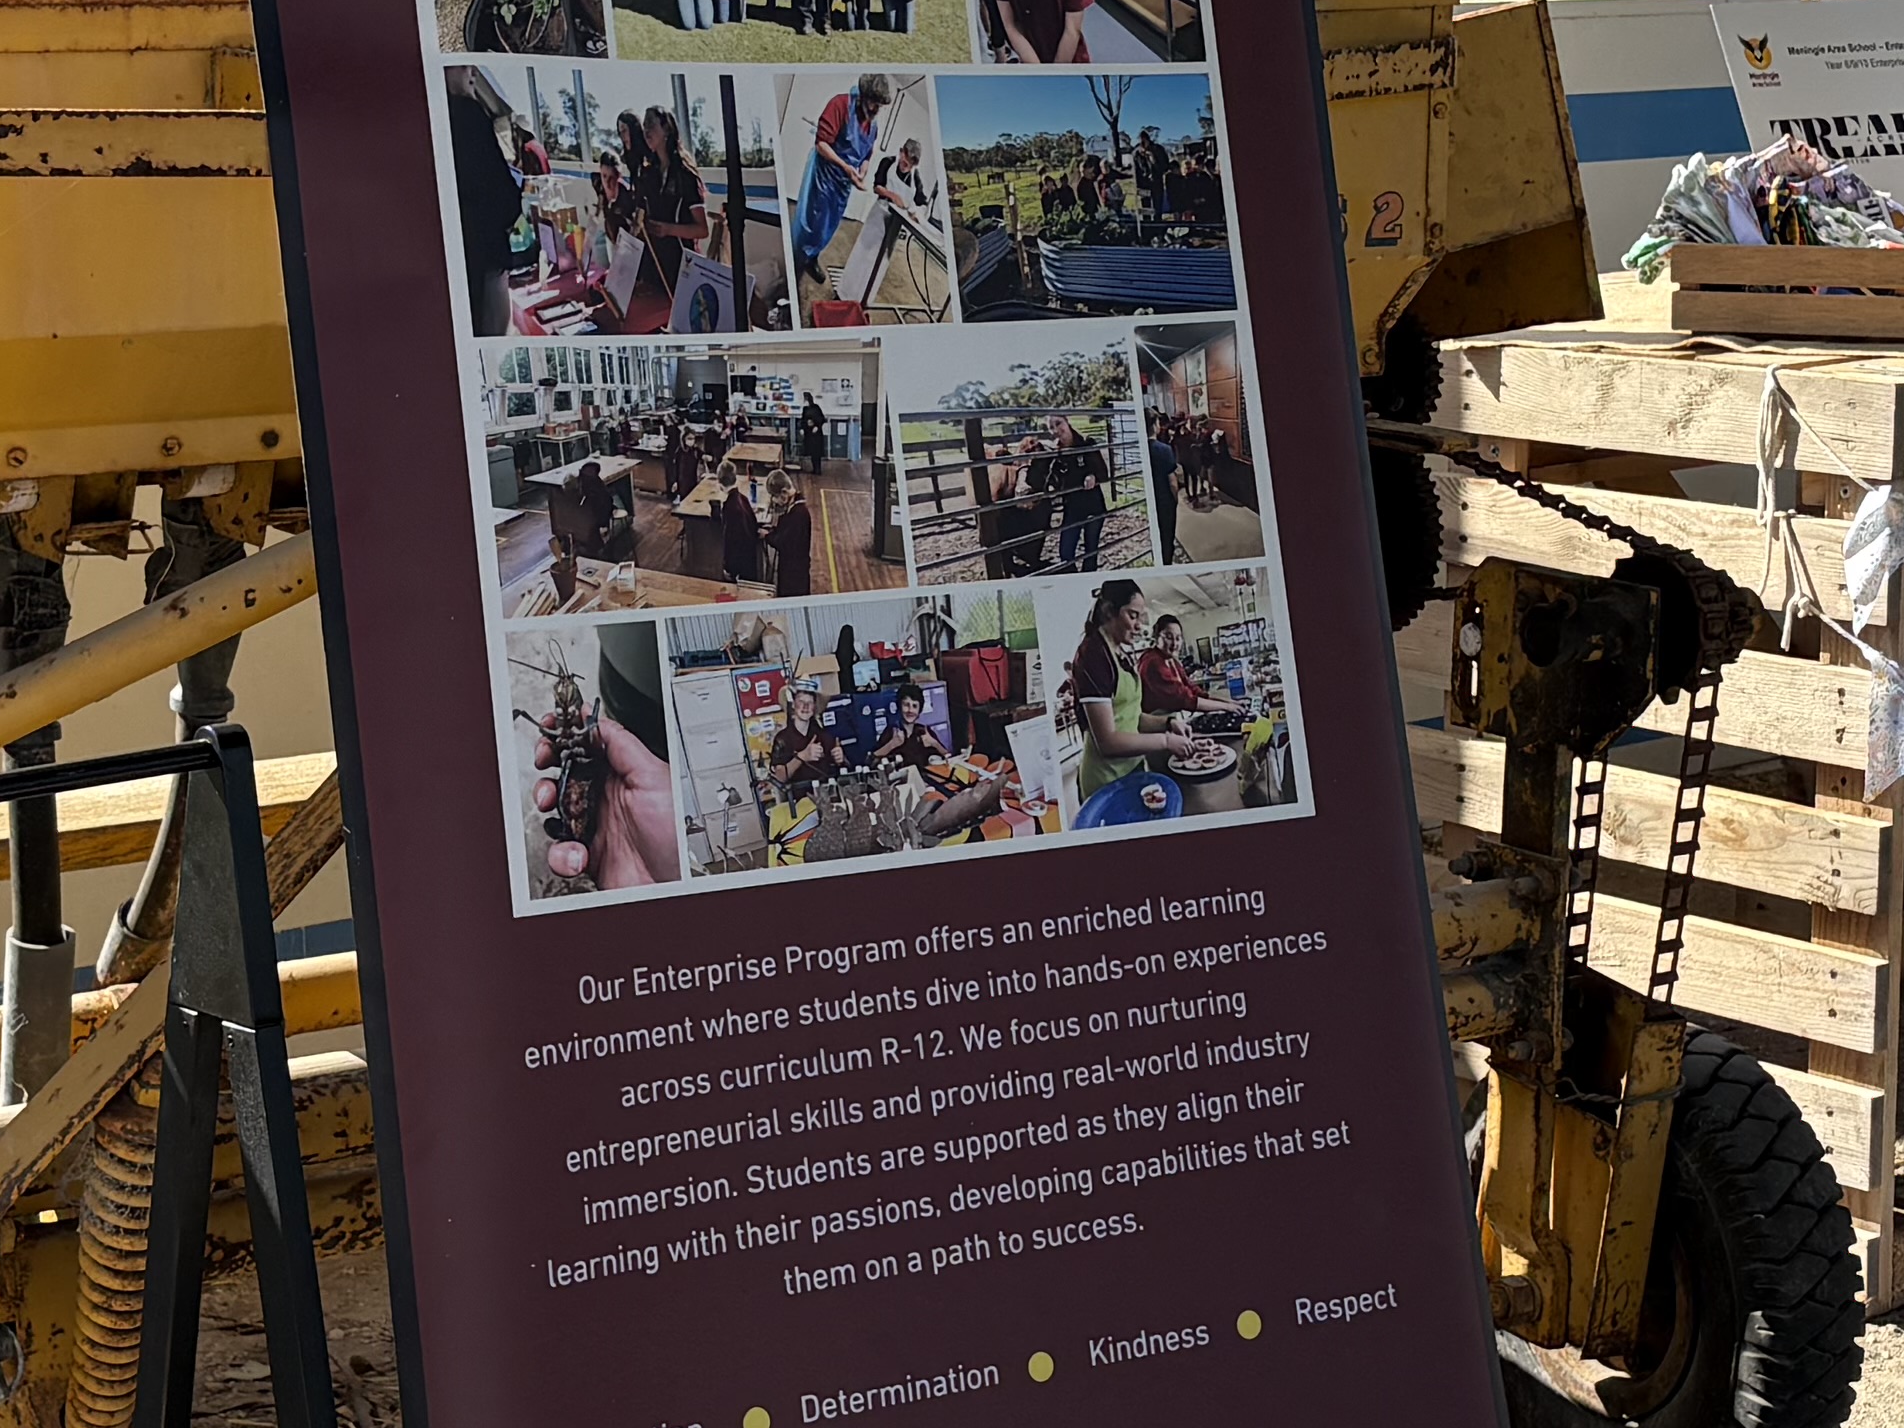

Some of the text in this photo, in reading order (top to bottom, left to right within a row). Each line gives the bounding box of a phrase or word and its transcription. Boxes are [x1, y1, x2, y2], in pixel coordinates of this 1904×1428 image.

[1365, 190, 1404, 247] 2
[524, 930, 1328, 1069] environment where students dive into hands-on experiences
[578, 887, 1266, 1005] Our Enterprise Program offers an enriched learning
[565, 1031, 1310, 1173] entrepreneurial skills and providing real-world industry
[620, 989, 1247, 1108] across curriculum R-12. We focus on nurturing
[547, 1120, 1351, 1288] learning with their passions, developing capabilities that set
[583, 1077, 1305, 1225] immersion. Students are supported as they align their
[783, 1212, 1145, 1296] them on a path to success.
[800, 1361, 1000, 1426] Determination
[1088, 1320, 1211, 1368] Kindness
[1295, 1282, 1399, 1328] Respect
